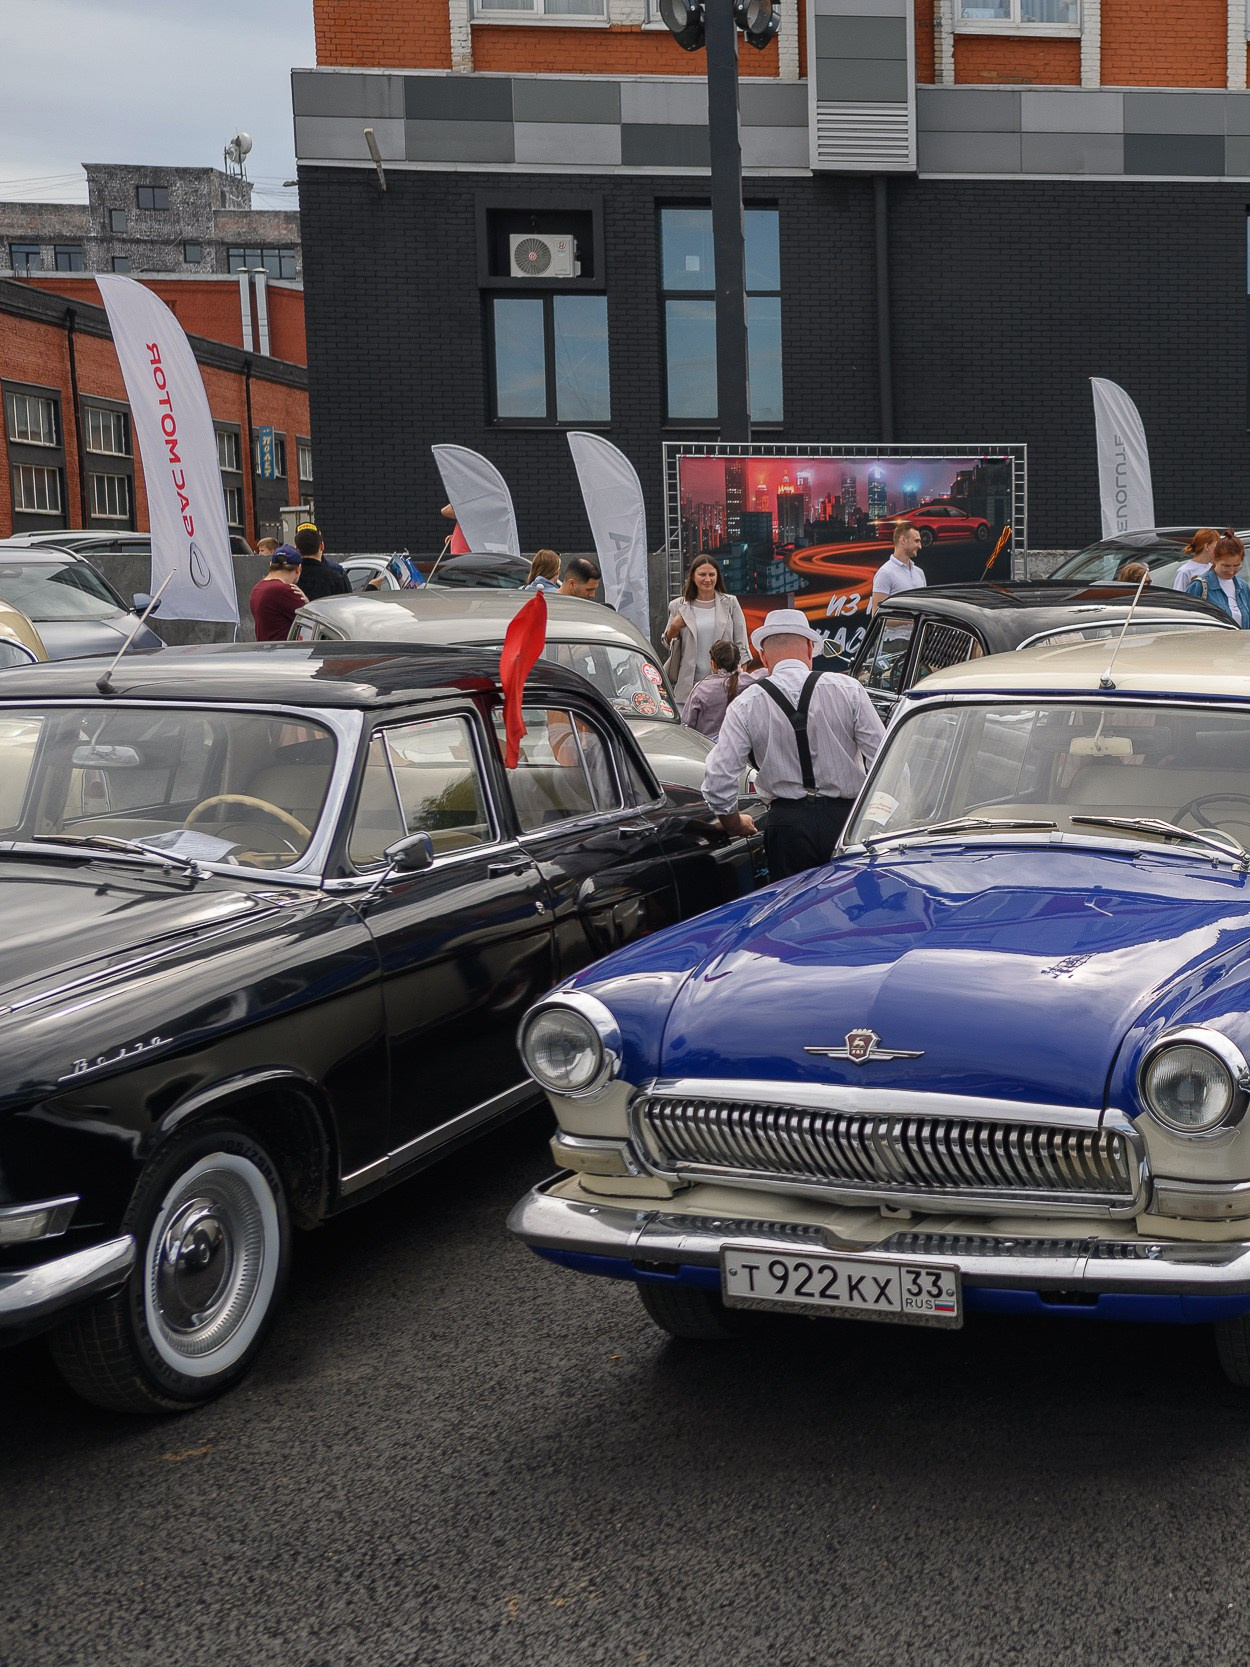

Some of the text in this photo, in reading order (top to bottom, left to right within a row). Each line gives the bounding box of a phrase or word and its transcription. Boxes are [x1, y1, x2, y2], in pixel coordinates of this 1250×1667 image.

[826, 593, 861, 617] ИЗ
[741, 1259, 943, 1305] Т922КХ 33
[905, 1298, 933, 1310] RUS
